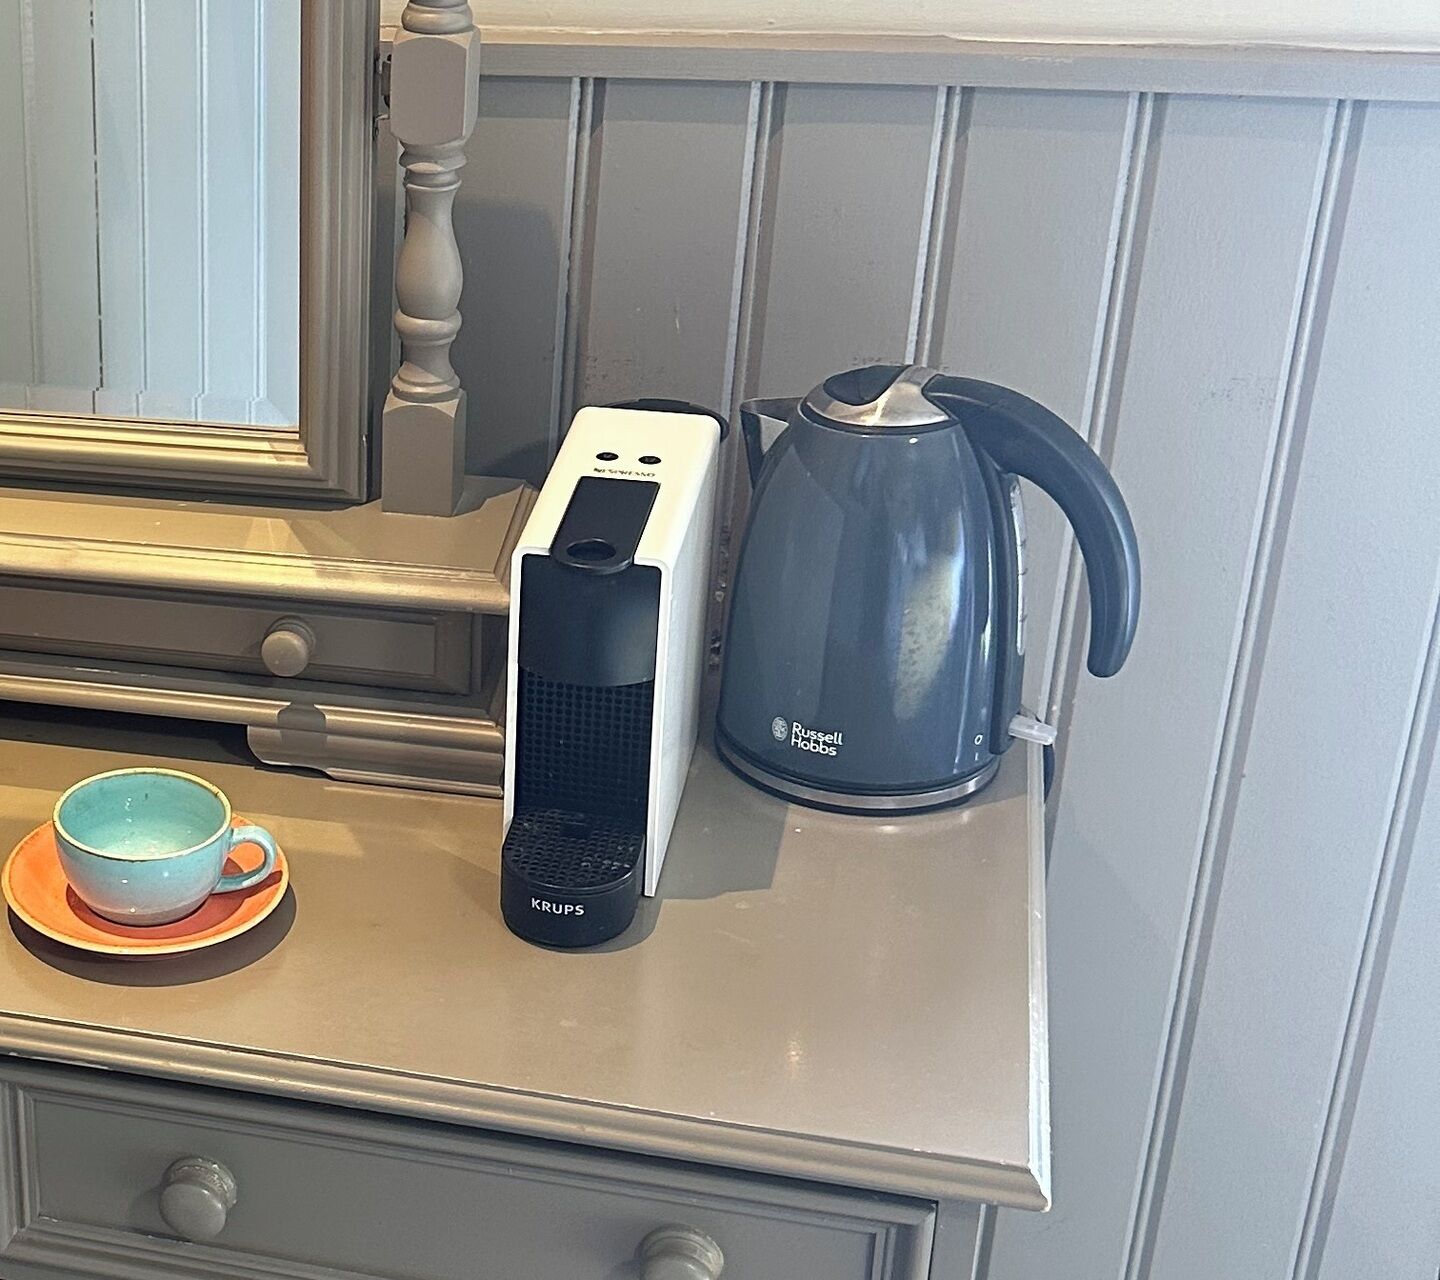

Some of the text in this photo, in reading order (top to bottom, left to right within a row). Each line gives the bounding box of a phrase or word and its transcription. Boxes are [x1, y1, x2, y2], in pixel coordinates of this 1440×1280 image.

[790, 733, 837, 756] Hobbs
[792, 721, 843, 745] Russell
[531, 897, 585, 916] KRUPS
